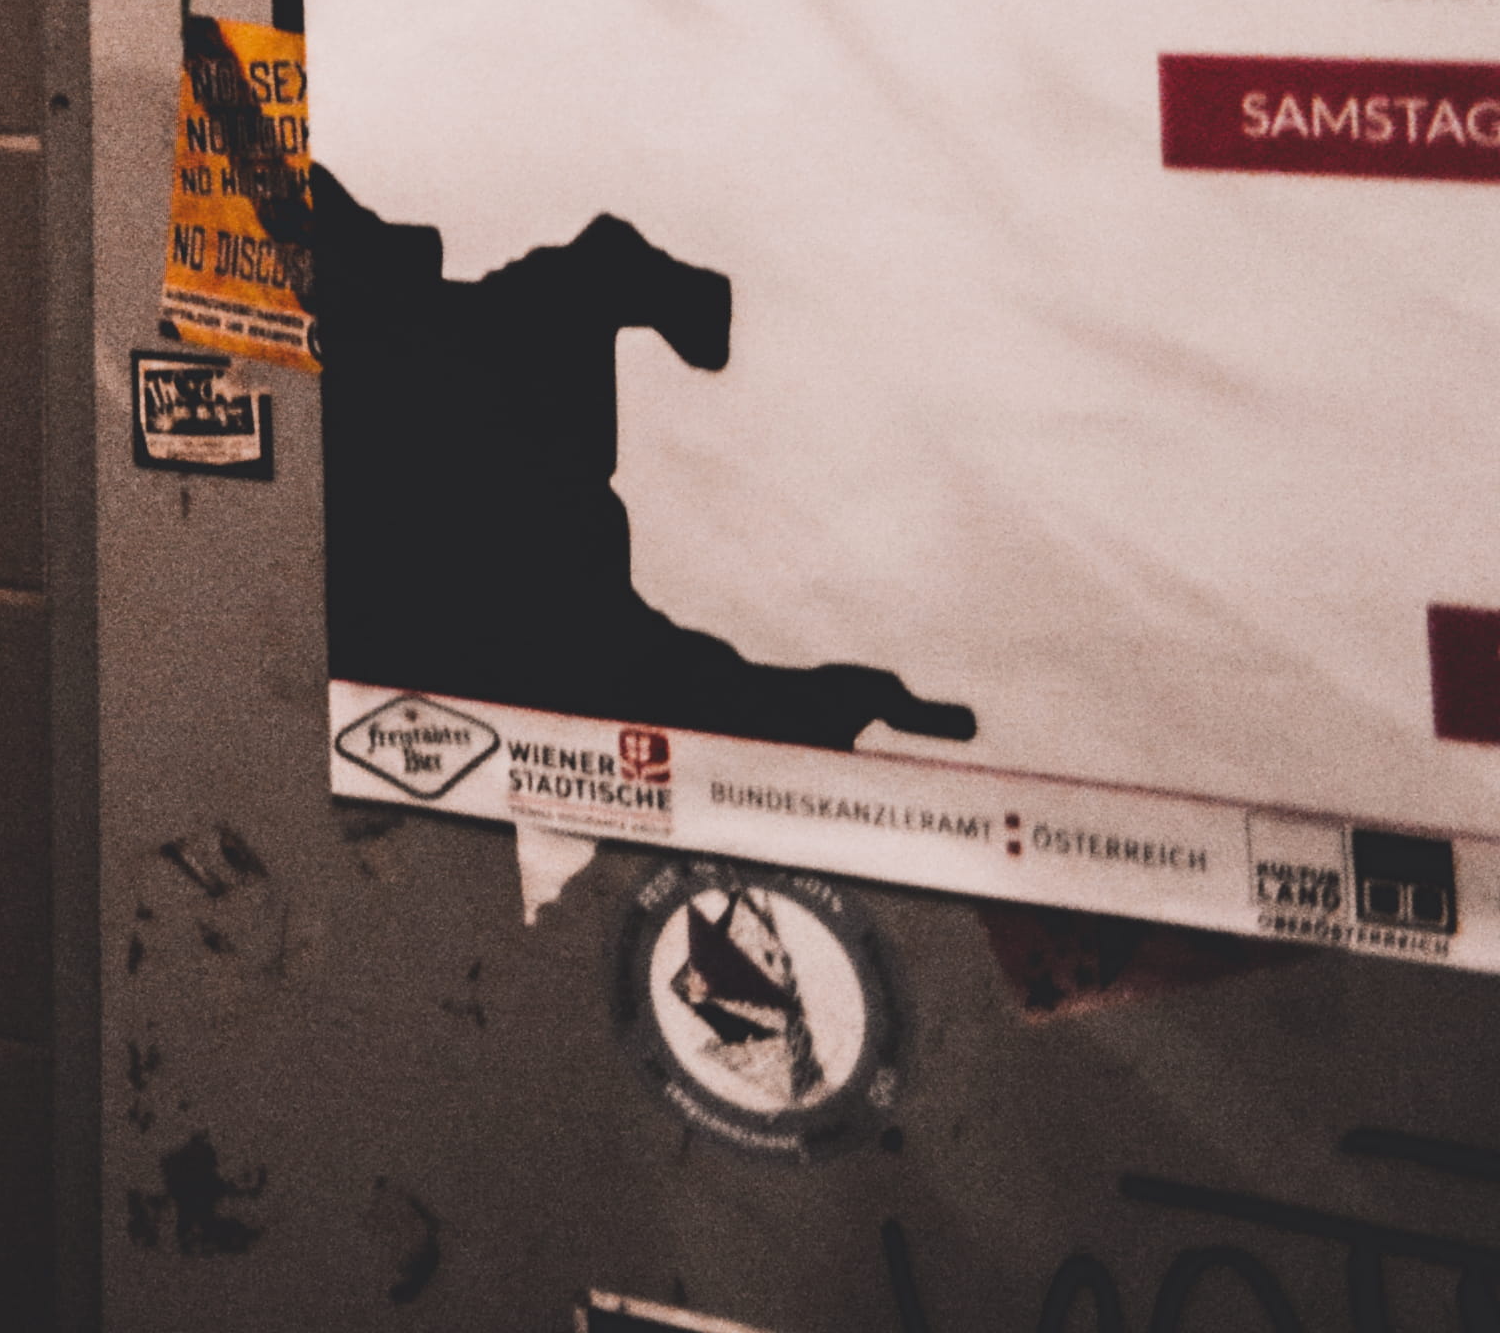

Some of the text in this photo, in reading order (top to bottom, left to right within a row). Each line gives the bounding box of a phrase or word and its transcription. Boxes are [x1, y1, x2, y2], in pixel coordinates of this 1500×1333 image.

[507, 741, 615, 777] WIENER
[711, 779, 992, 841] BUNDESKANZLERAMT
[1031, 821, 1207, 873] ÖSTERREICH
[1257, 879, 1340, 912] LAND
